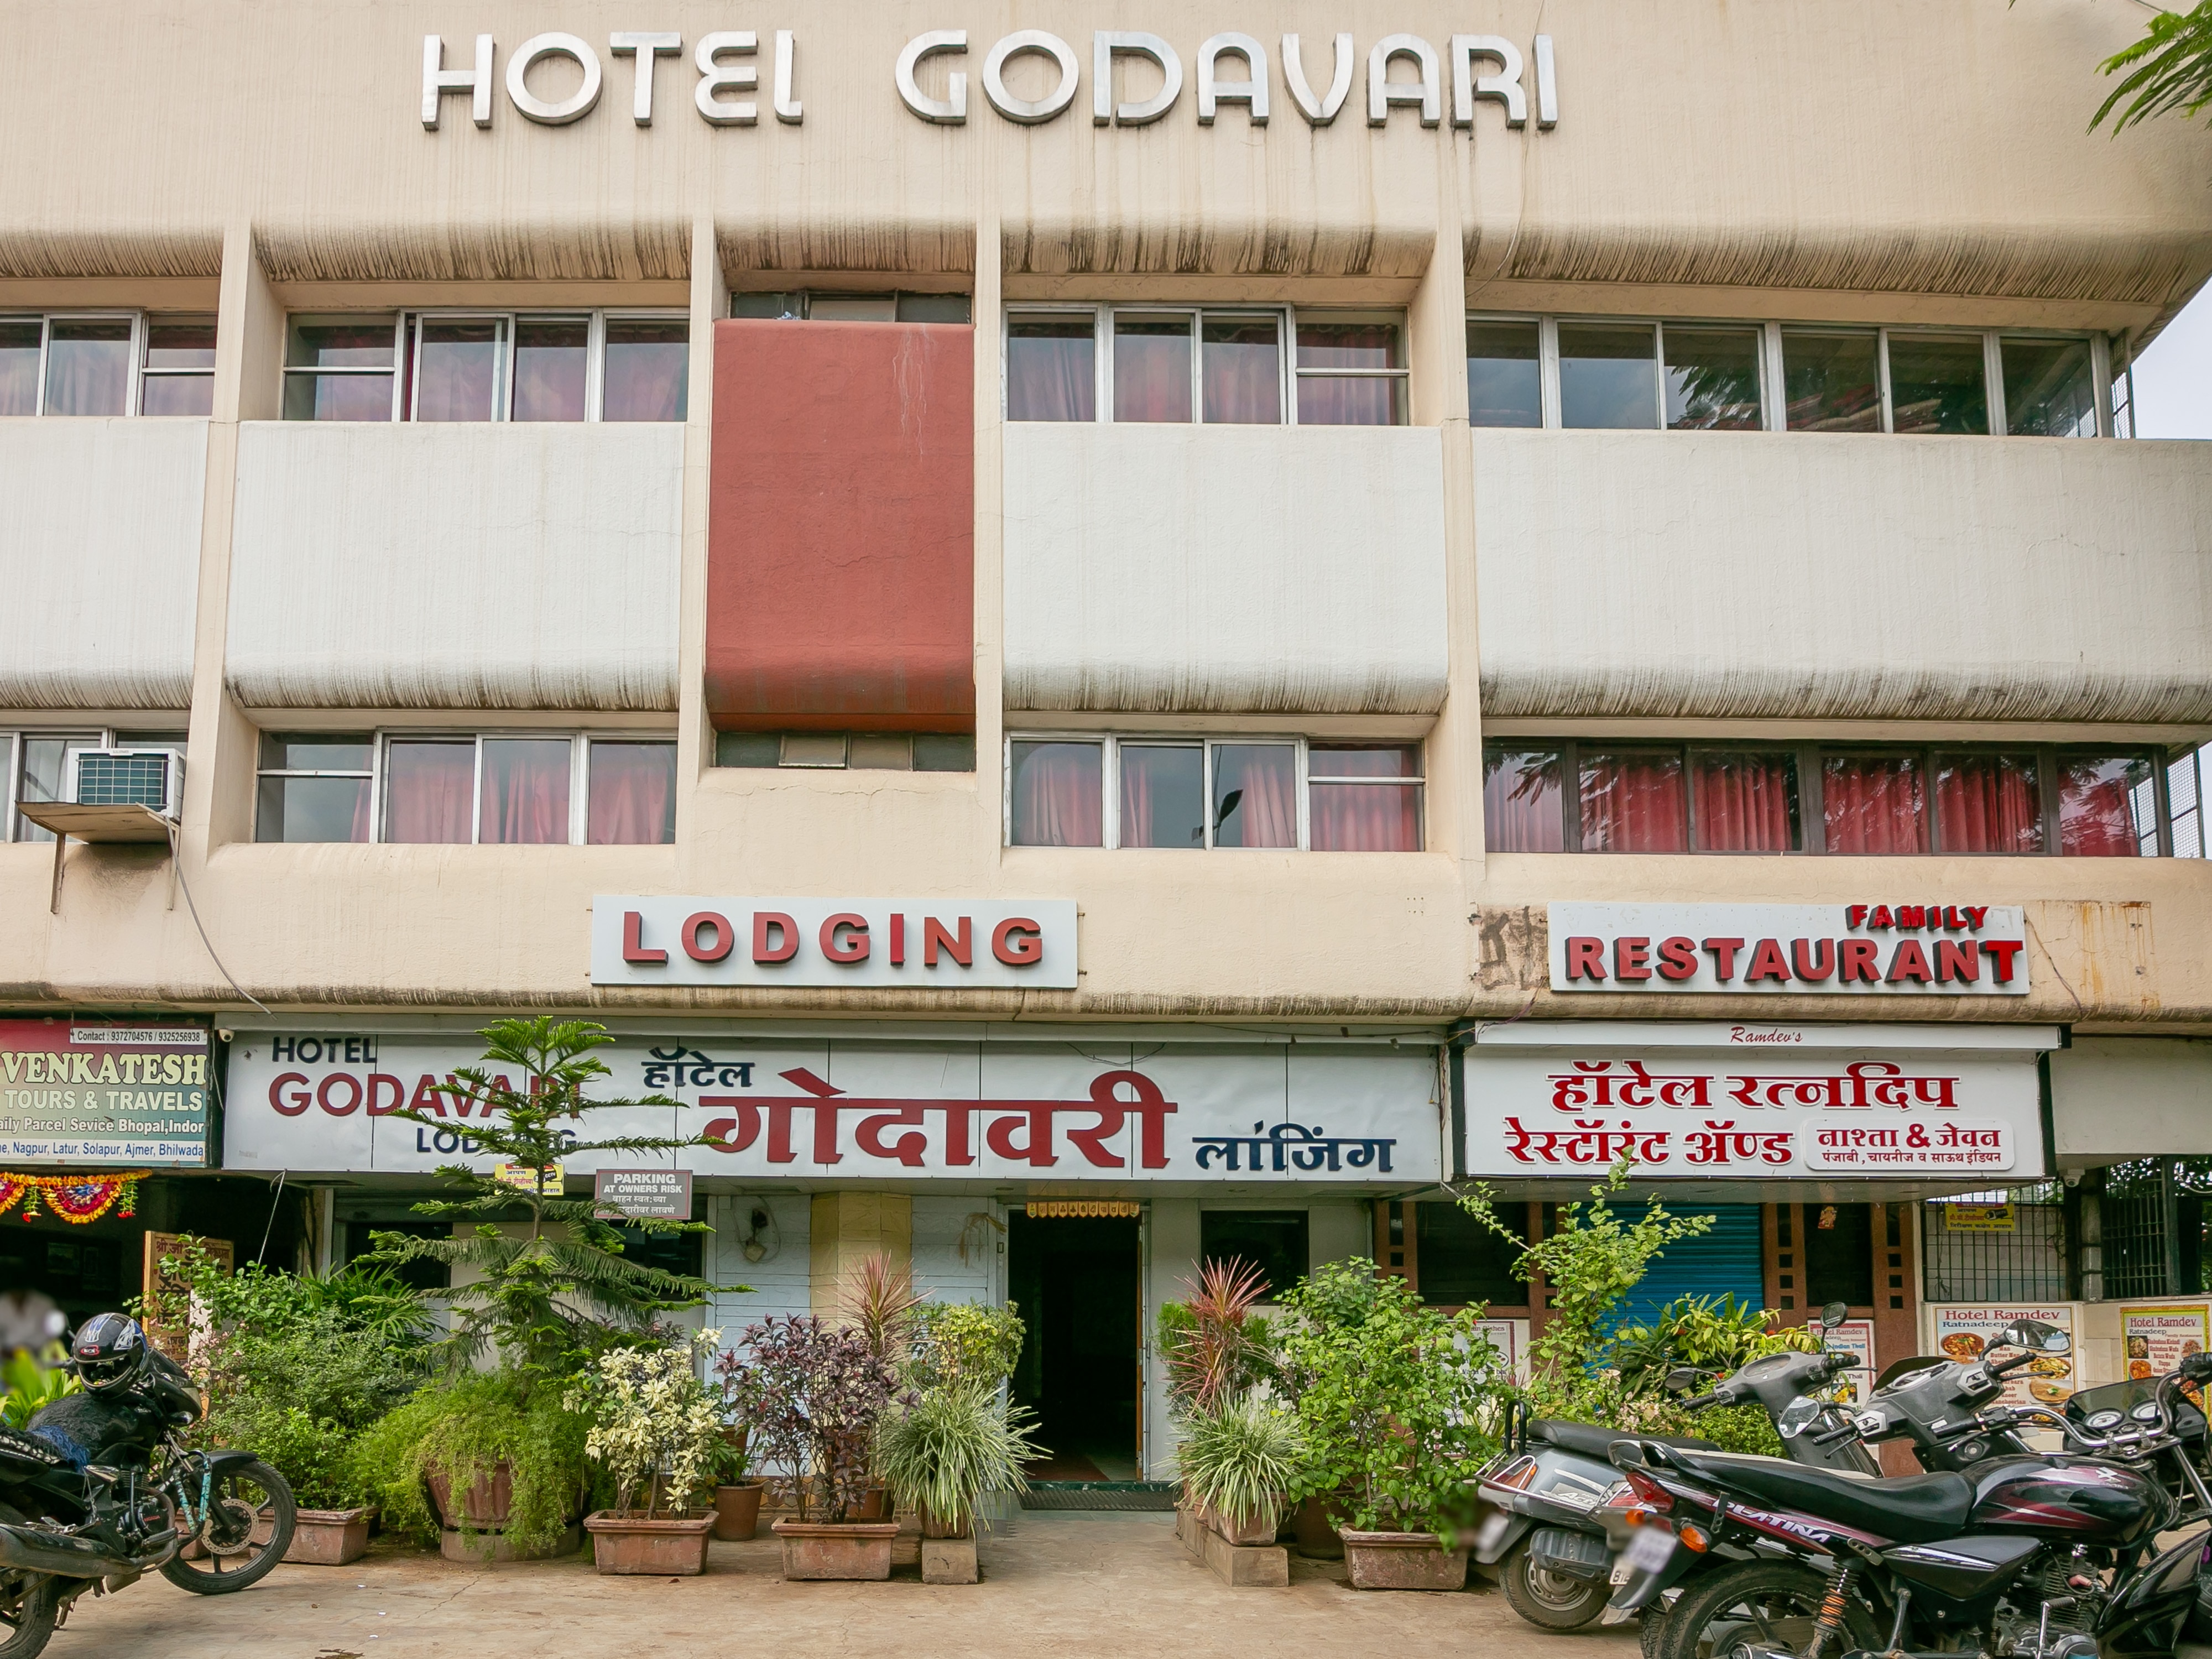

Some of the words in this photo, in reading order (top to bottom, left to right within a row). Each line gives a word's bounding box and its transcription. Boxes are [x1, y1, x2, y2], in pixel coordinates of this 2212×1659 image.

[422, 30, 804, 131] HOTEL
[895, 30, 1558, 132] GODAVARI
[1846, 904, 1989, 931] FAMILY
[623, 911, 1043, 966] LODGING
[1564, 936, 2023, 984] RESTAURANT
[78, 1031, 105, 1041] Contact
[111, 1031, 152, 1041] 9372704576
[159, 1032, 200, 1042] 9325256938
[1730, 1026, 1803, 1044] Ramdev's
[273, 1037, 378, 1063] HOTEL
[1, 1052, 207, 1084] VENKATESH
[641, 1046, 755, 1088] हॉटेल
[1546, 1060, 1715, 1112] हॉटेल
[4, 1089, 76, 1109] TOURS
[84, 1091, 98, 1110] &
[106, 1091, 202, 1111] TRAVELS
[0, 1117, 20, 1134] aily
[24, 1117, 66, 1131] Parcel
[70, 1118, 114, 1132] Sevice
[699, 1067, 1178, 1168] गोदावरी
[1817, 1129, 1899, 1147] नाश्ता
[1906, 1124, 1931, 1147] &
[1935, 1123, 2001, 1147] जेवन
[159, 1143, 204, 1157] Bhilwada
[604, 1185, 615, 1193] AT
[618, 1185, 658, 1193] OWNERS
[662, 1185, 682, 1193] RISK
[614, 1174, 676, 1184] PARKING
[1945, 1310, 1988, 1320] Hotel
[1994, 1310, 2060, 1320] Ramdev
[2130, 1317, 2154, 1327] Hotel
[2157, 1317, 2197, 1327] Ramdev
[1712, 1499, 1832, 1543] PLATINA
